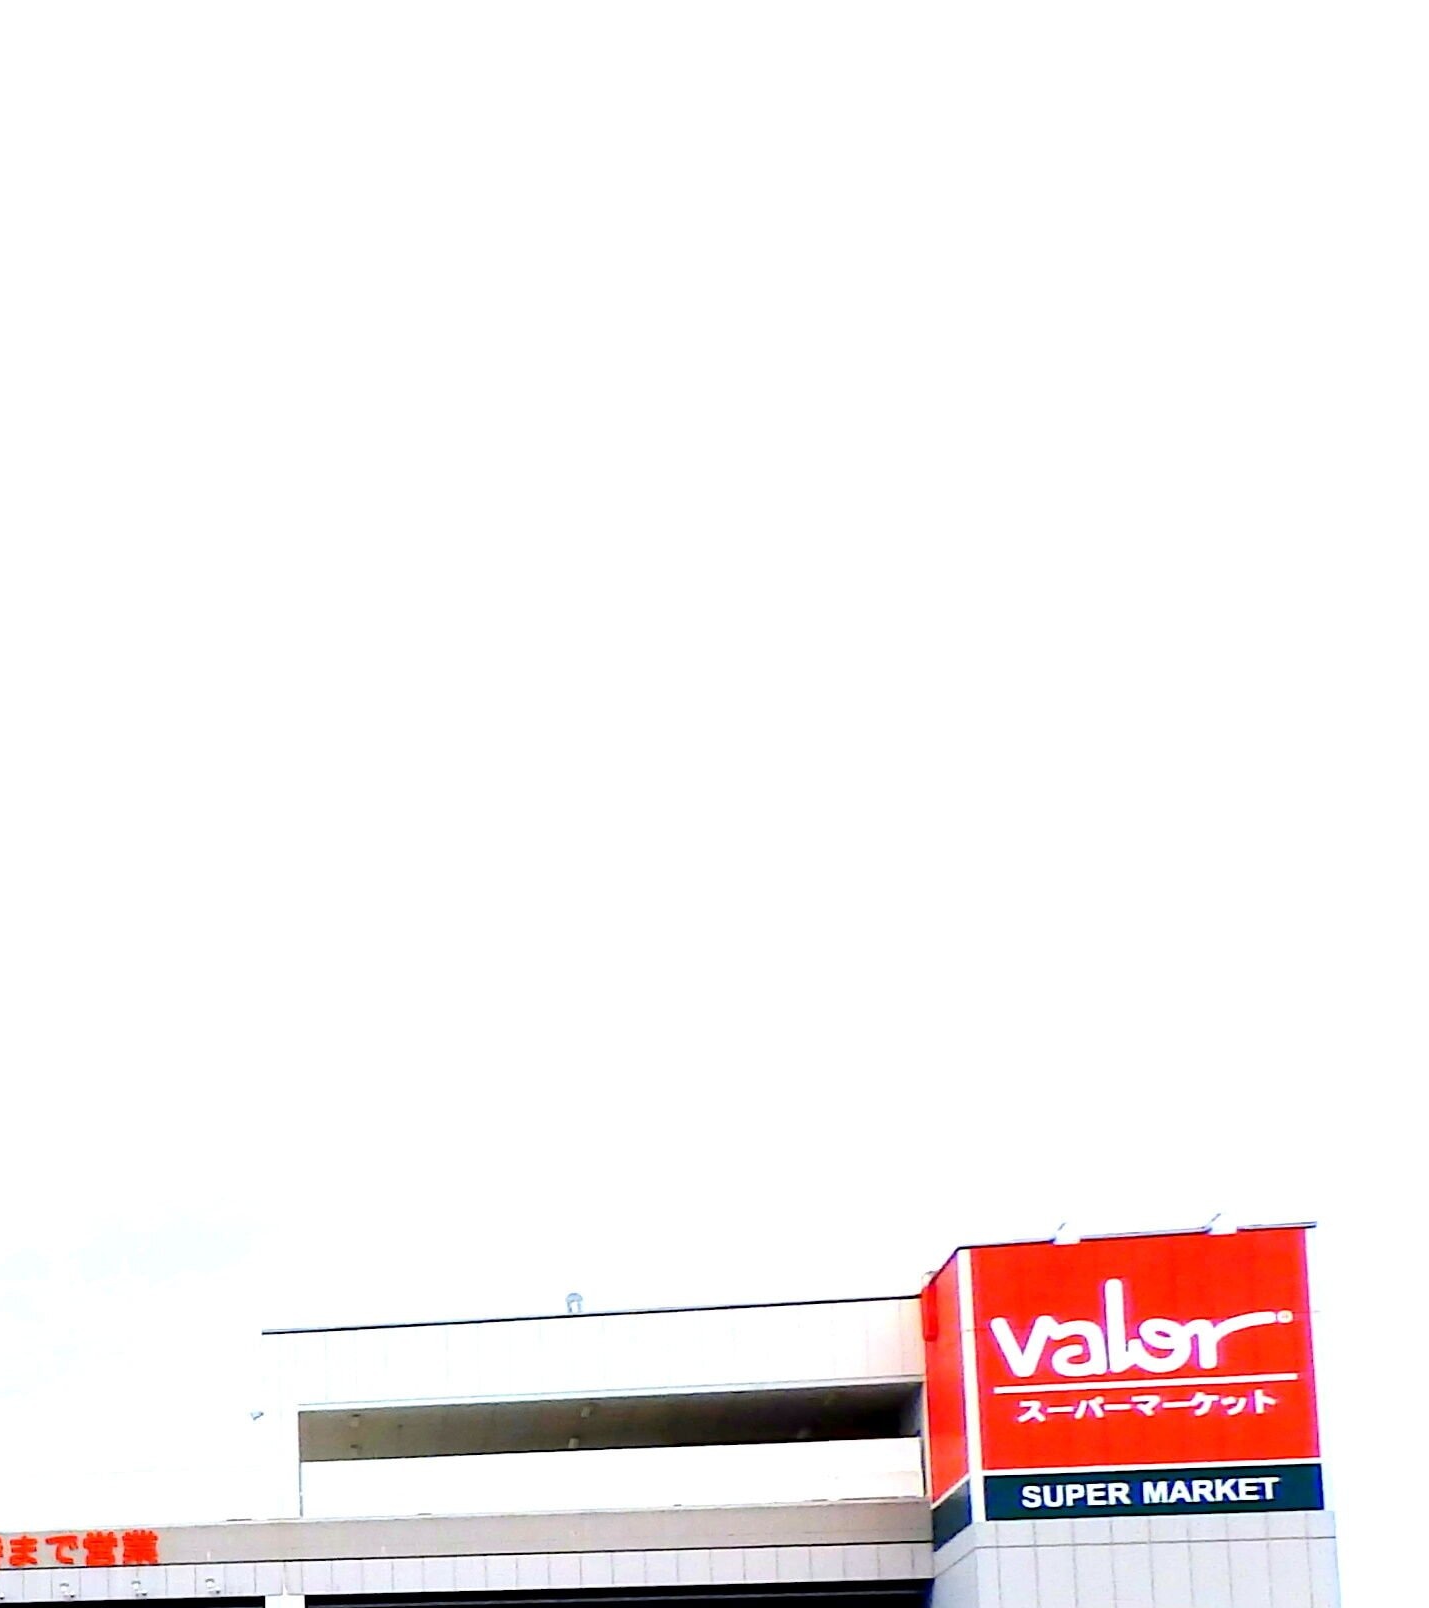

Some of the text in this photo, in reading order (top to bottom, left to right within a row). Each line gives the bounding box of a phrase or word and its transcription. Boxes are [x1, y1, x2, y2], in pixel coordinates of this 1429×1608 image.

[989, 1278, 1280, 1378] valor
[1017, 1388, 1278, 1423] スーパーマーケット
[1021, 1476, 1281, 1509] SUPER MARKET
